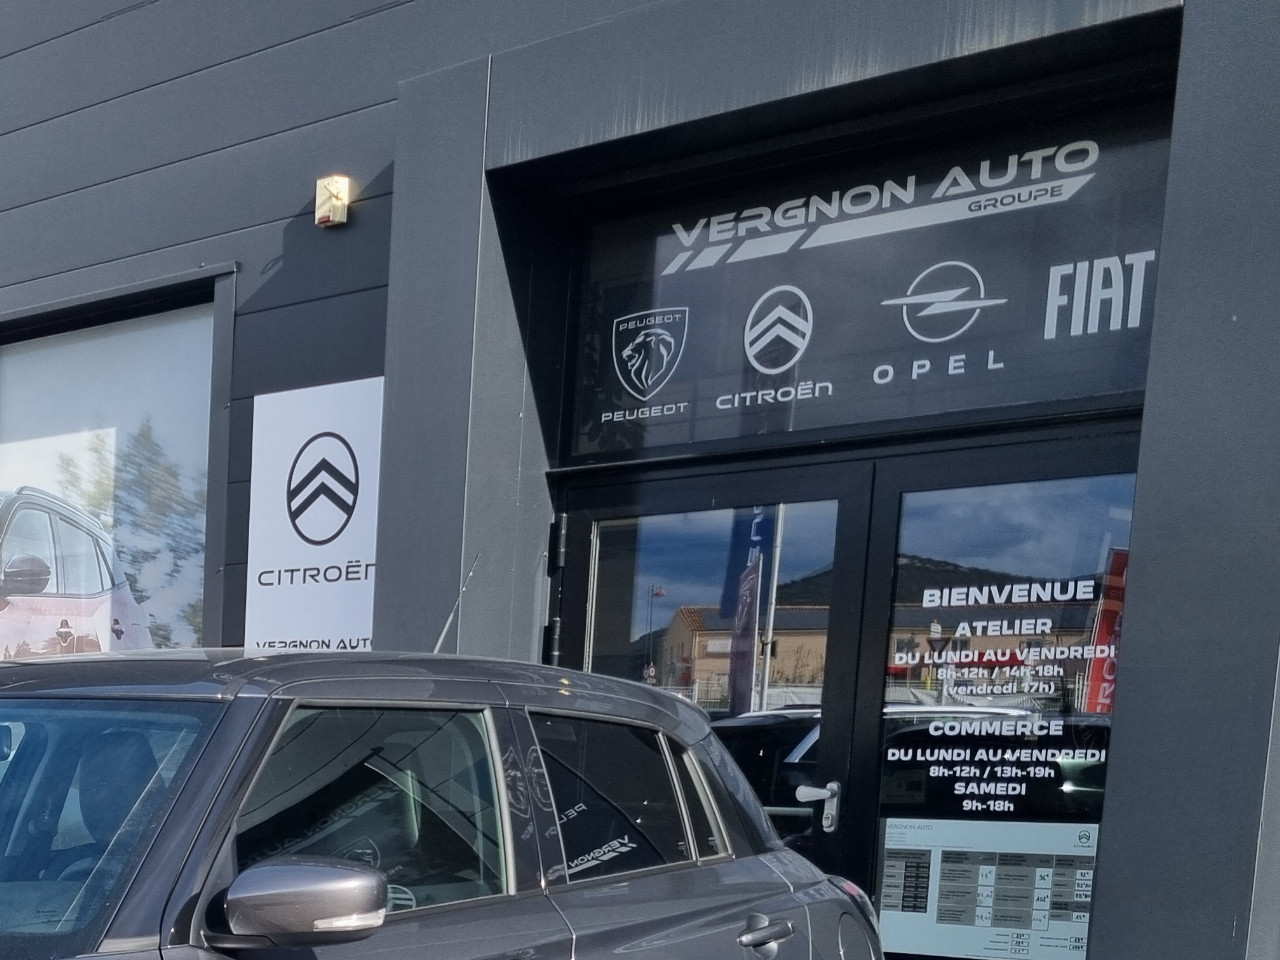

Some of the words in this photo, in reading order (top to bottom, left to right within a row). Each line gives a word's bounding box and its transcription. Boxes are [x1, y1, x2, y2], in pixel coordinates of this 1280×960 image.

[672, 175, 916, 248] VERGNON
[931, 140, 1100, 199] AUTO
[967, 183, 1064, 213] GROUPE
[1043, 250, 1155, 340] FIAT
[619, 314, 682, 331] PEUGEOT
[872, 350, 1004, 385] OPEL
[601, 403, 688, 422] PEUGEOT
[922, 579, 1095, 608] BIENVENUE
[954, 618, 1052, 637] ATELIER
[336, 637, 373, 650] AUT
[894, 652, 920, 665] DU
[924, 650, 979, 664] LUNDI
[983, 648, 1011, 662] AU
[1015, 645, 1115, 661] VENDREDI
[937, 667, 989, 680] 8h-12h
[1003, 665, 1064, 678] 14h-18h
[943, 683, 1017, 697] (vendredi
[1023, 682, 1055, 695] 17h)
[928, 720, 1064, 736] COMMERCE
[887, 749, 913, 761] DU
[916, 749, 970, 762] LUNDI
[975, 749, 1002, 762] AU
[1005, 749, 1106, 762] VENDREDI
[929, 766, 980, 778] 8h-12h
[994, 766, 1055, 778] 13h-19h
[953, 782, 1027, 796] SAMEDI
[962, 799, 1014, 812] 9h-18h
